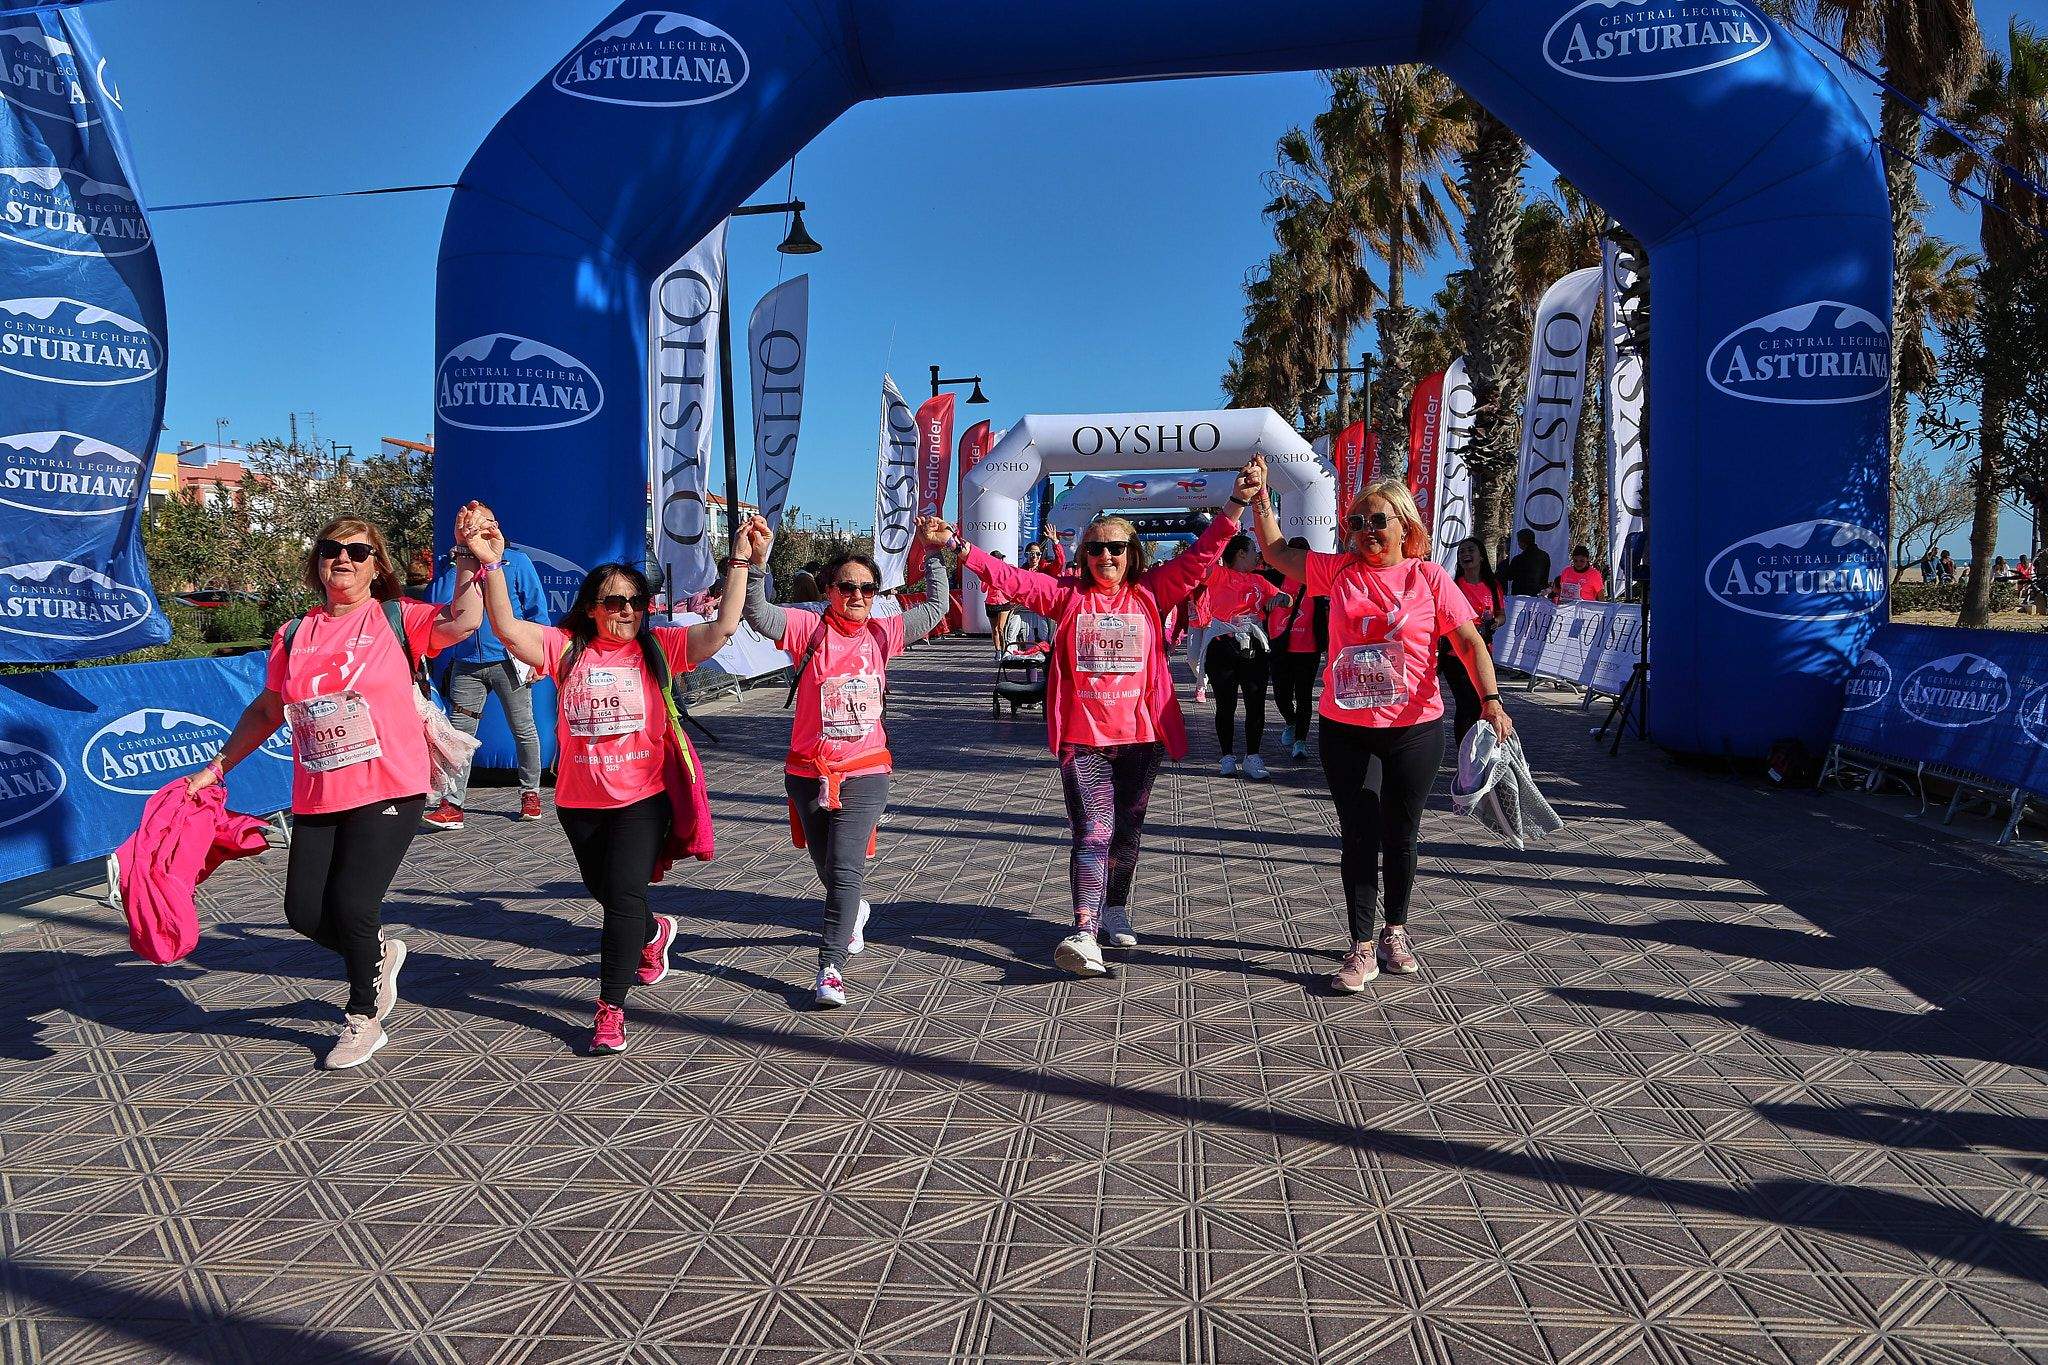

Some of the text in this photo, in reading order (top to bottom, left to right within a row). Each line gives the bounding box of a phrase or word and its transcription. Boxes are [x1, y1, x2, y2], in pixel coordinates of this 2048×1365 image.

[1600, 7, 1746, 27] CENTRAL LECHERA
[594, 40, 727, 55] CENTRAL LECHERA
[1561, 21, 1761, 64] ASTURIANA
[562, 53, 734, 85] ASTURIANA
[0, 201, 149, 239] STURIANA
[4, 320, 147, 345] CENTRAL LECHERA
[1759, 337, 1834, 350] CENTRAL
[0, 333, 152, 370] STURIANA
[454, 367, 584, 383] CENTRAL LECHERA
[1722, 345, 1888, 384] ASTURIANA
[439, 372, 590, 411] ASTURIANA
[658, 268, 712, 546] OYSHO
[1523, 311, 1583, 532] OYSHO
[1072, 422, 1221, 456] OYSHO
[1417, 395, 1439, 485] Santander
[8, 455, 139, 475] CENTRAL LECHERA
[924, 418, 942, 499] Santander
[985, 462, 1030, 473] OYSHO
[1264, 453, 1310, 464] OYSHO
[0, 468, 139, 499] STURIANA
[879, 401, 917, 554] OYSHO
[966, 521, 1007, 531] OYSHO
[1289, 515, 1332, 526] OYSHO
[1757, 554, 1831, 566] CENTRAL
[1720, 558, 1885, 595] ASTURIANA
[10, 584, 71, 597] CENTRAL
[0, 597, 142, 623] STURIANA
[1099, 639, 1124, 649] 016
[1358, 672, 1385, 684] 016
[590, 696, 620, 710] 016
[1903, 676, 2000, 713] ASTURIANA
[118, 728, 220, 751] CENTRAL LECHERA
[315, 726, 346, 742] 016
[604, 755, 614, 764] DE
[615, 754, 625, 763] LA
[625, 750, 650, 761] MUJER
